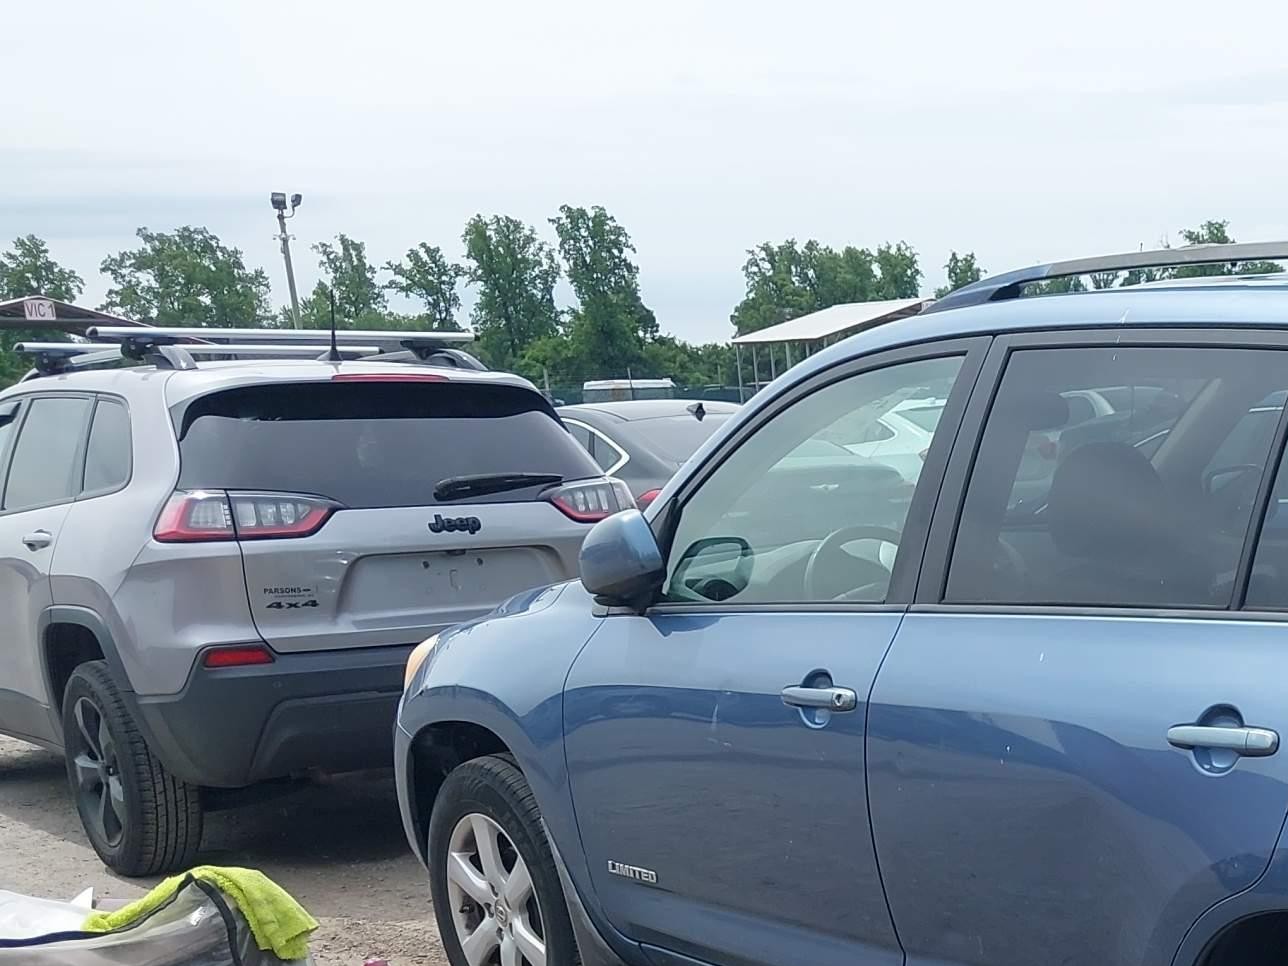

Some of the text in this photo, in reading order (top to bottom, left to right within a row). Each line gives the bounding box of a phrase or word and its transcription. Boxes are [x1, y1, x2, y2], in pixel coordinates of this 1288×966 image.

[25, 302, 46, 317] VIC
[428, 513, 482, 535] Jeep
[263, 586, 301, 595] PARSONS
[265, 599, 320, 610] 4x4
[607, 860, 657, 883] LIMITED
